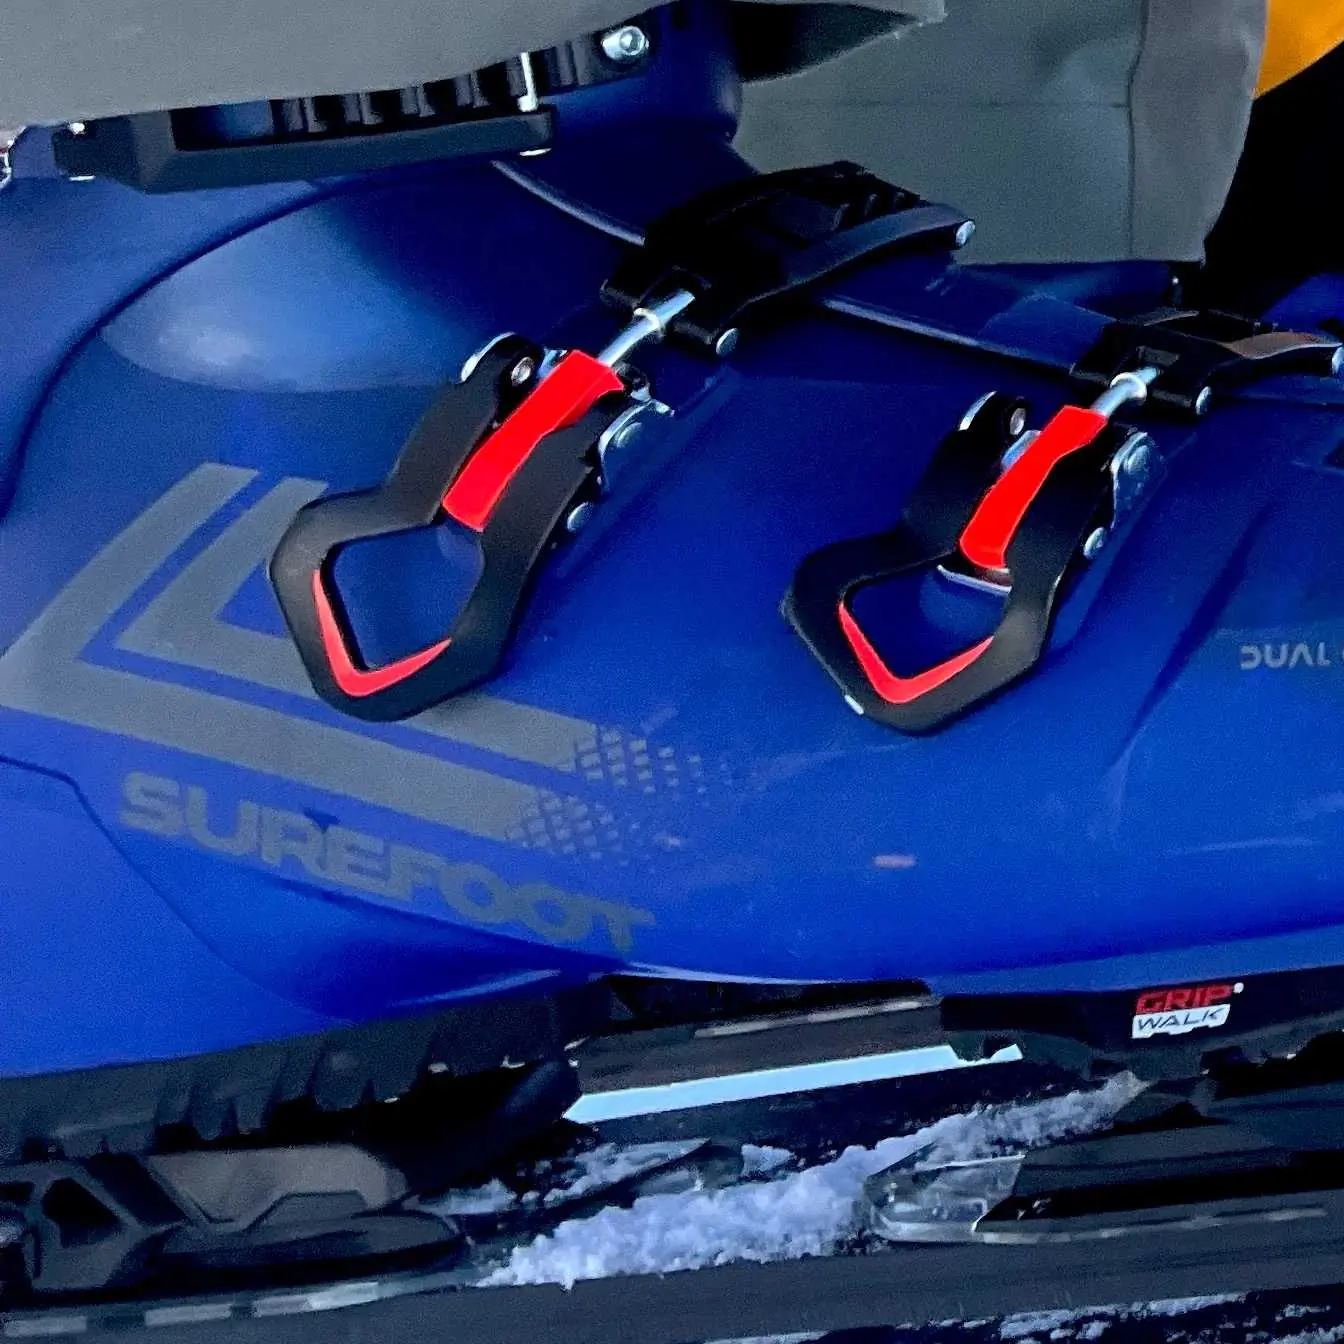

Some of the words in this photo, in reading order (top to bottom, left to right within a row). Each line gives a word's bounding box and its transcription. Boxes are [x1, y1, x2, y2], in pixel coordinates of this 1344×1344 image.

[1240, 640, 1331, 670] DUAL
[118, 770, 656, 952] SUREFOOT
[1135, 983, 1232, 1015] GRIP
[1138, 1006, 1225, 1031] WALK
